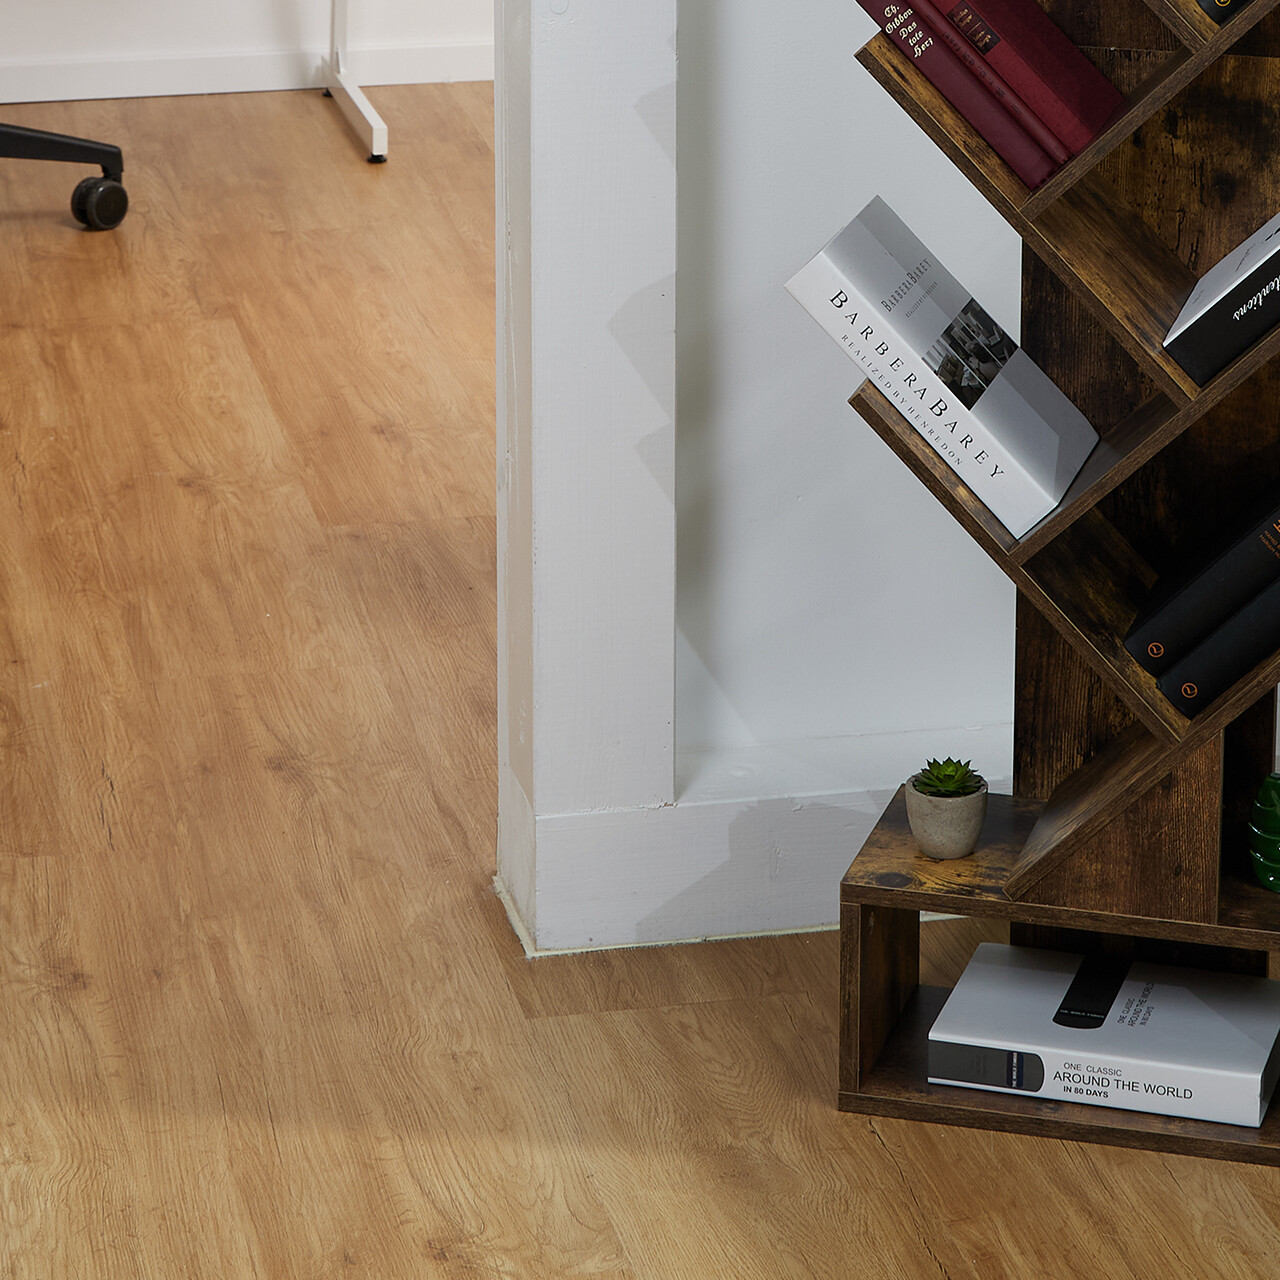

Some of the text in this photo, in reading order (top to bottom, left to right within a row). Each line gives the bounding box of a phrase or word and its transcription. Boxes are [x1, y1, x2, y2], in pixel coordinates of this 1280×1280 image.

[899, 22, 917, 39] Das
[841, 334, 963, 466] REALIZED BY HENREDON
[1063, 1062, 1122, 1076] ONE CLASSIC
[1053, 1071, 1193, 1100] AROUND THE WORLD
[1063, 1086, 1109, 1098] IN 80 DAYS
